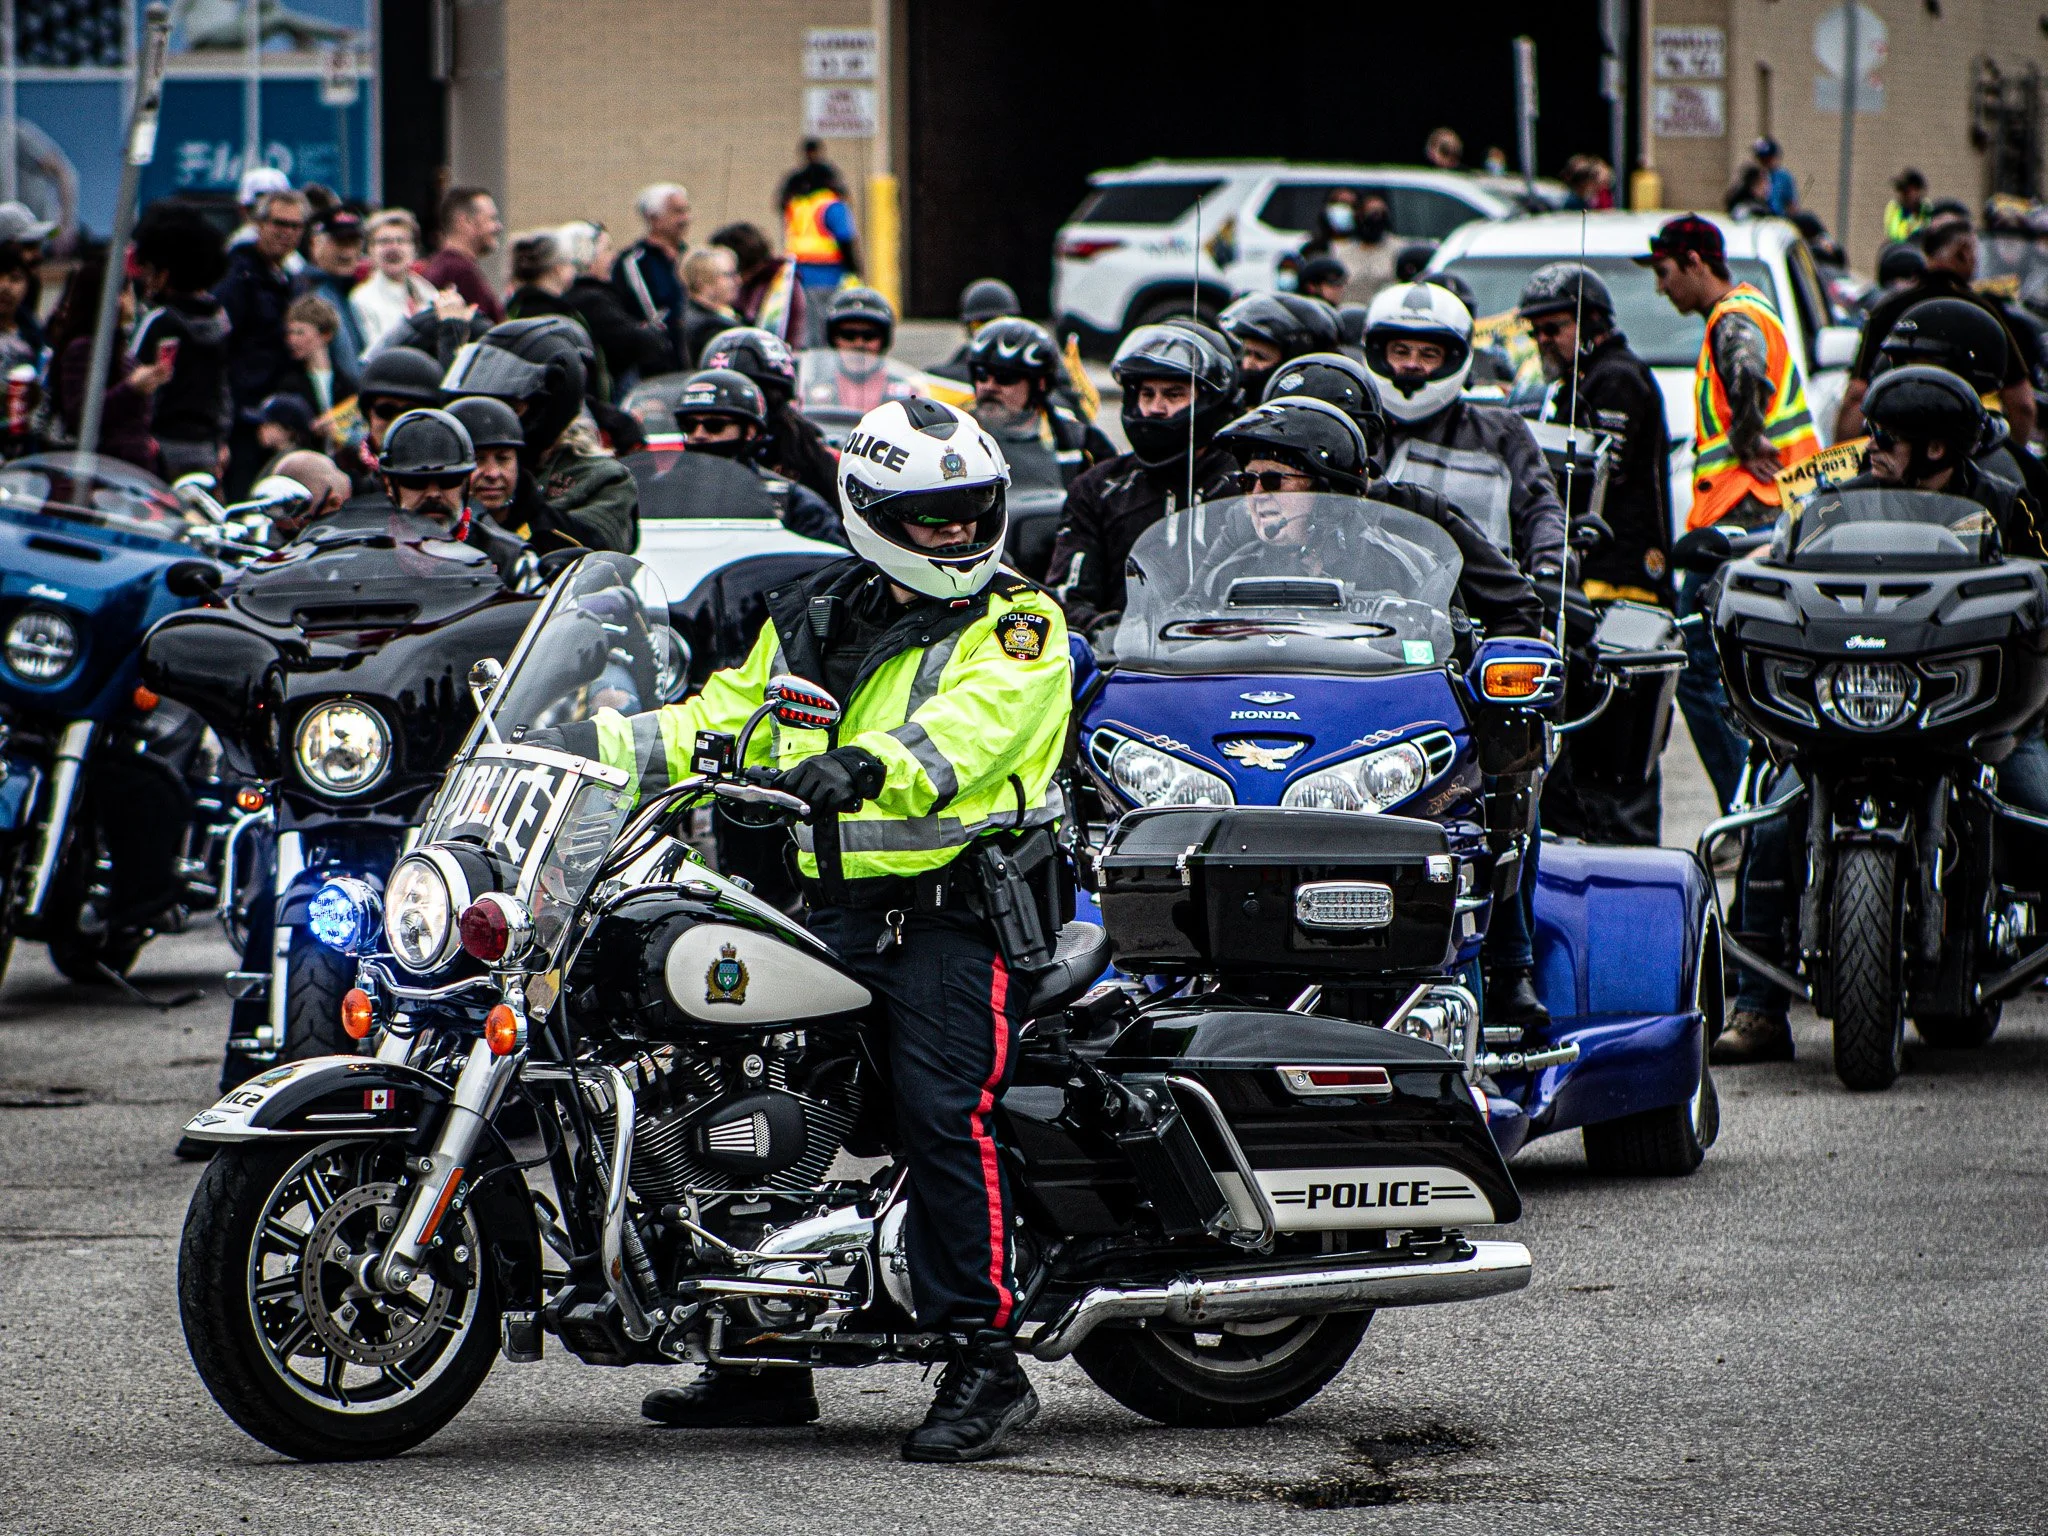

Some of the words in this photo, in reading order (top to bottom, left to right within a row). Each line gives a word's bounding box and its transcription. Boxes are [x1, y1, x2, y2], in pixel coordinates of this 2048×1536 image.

[844, 432, 910, 473] OLICE
[1001, 613, 1043, 624] POLICE
[1230, 711, 1301, 721] HONDA
[436, 764, 556, 865] POLICE
[1307, 1180, 1430, 1209] POLICE
